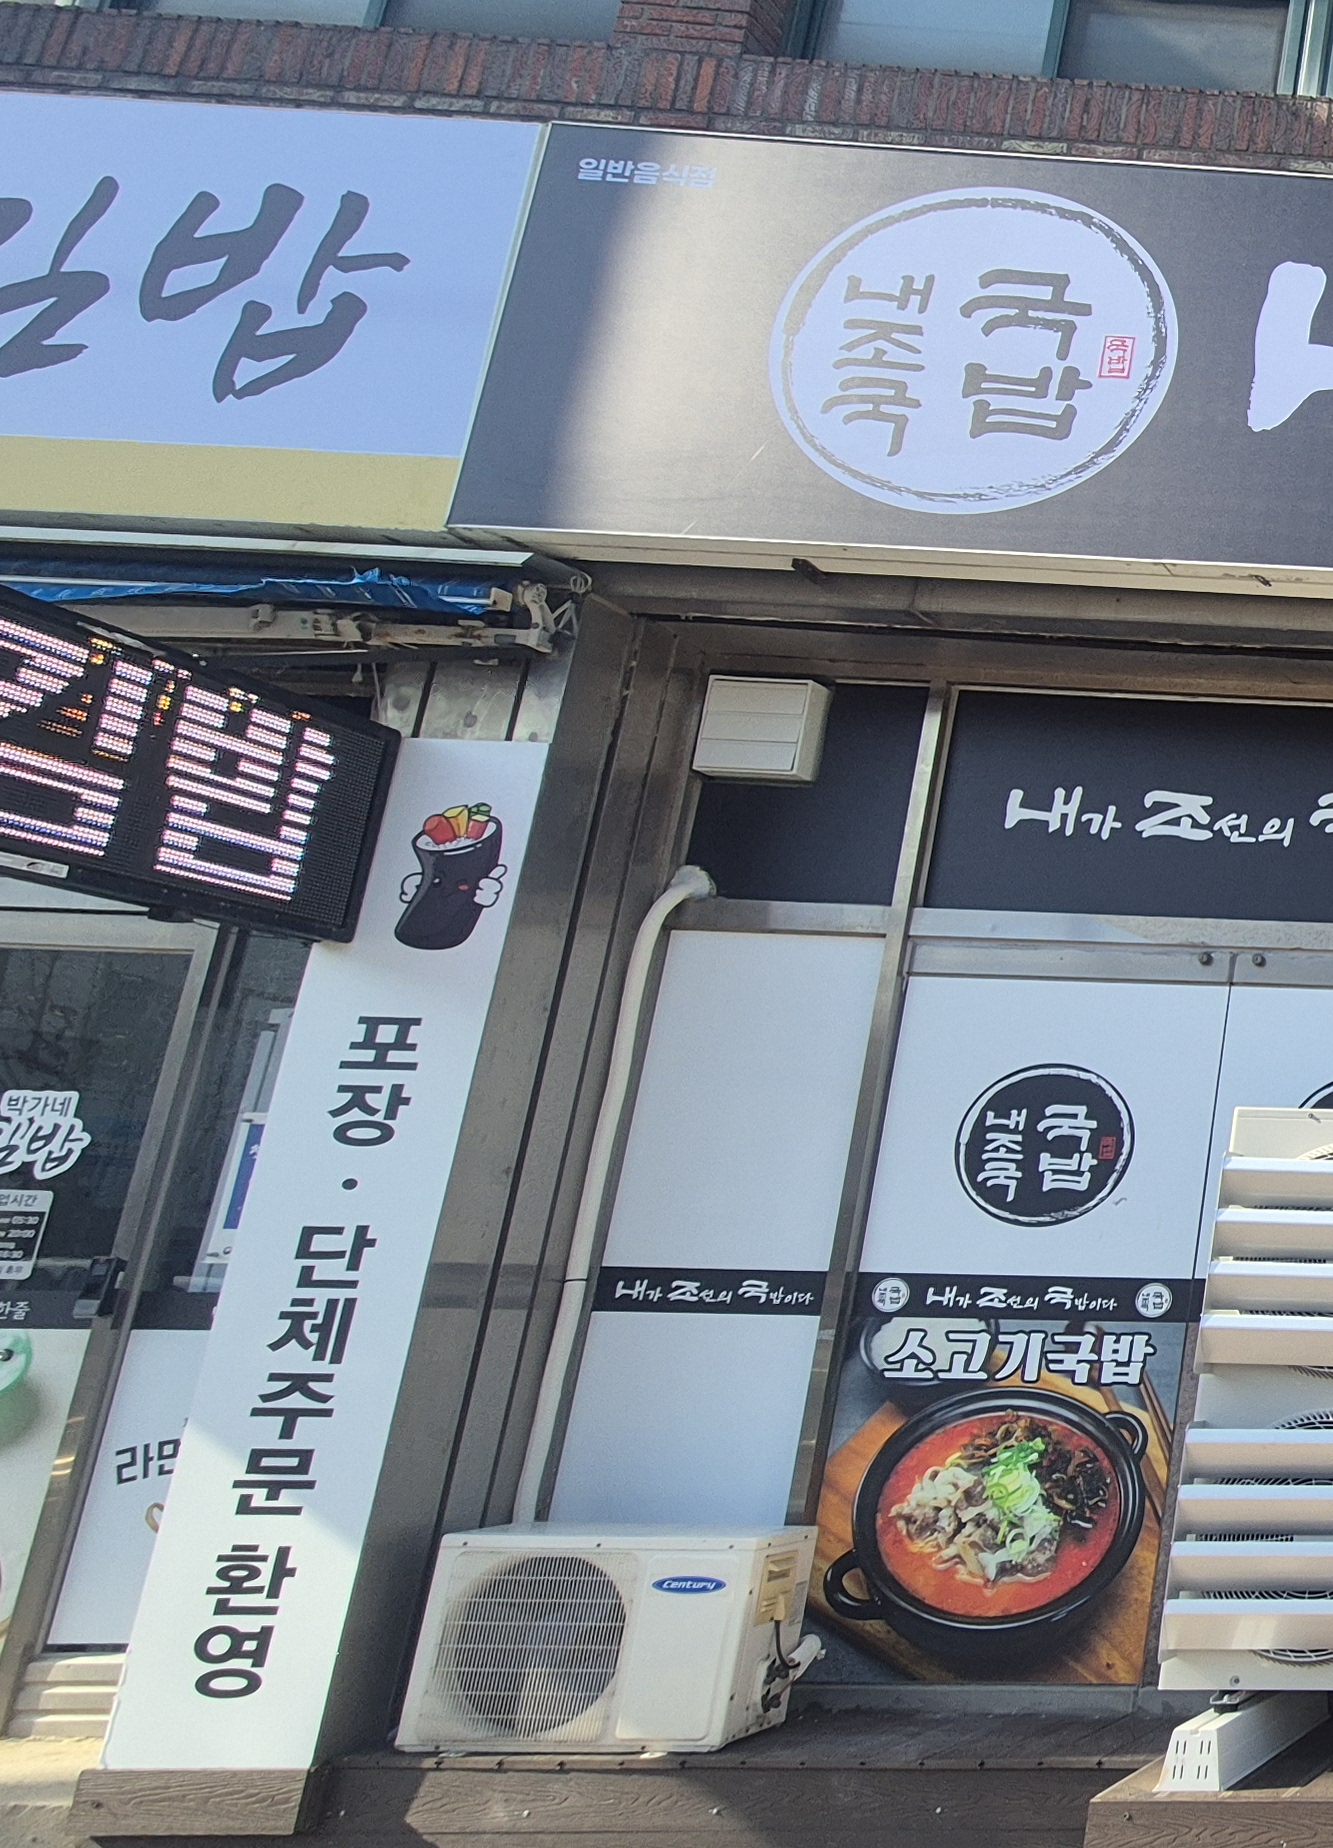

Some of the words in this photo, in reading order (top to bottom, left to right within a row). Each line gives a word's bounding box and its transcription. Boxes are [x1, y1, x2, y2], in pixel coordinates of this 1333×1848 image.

[577, 157, 718, 189] 일반음식점
[821, 274, 935, 457] 내조국
[959, 269, 1093, 440] 국밥
[1004, 786, 1122, 840] 내가
[1135, 790, 1295, 848] 조선의
[7, 1094, 73, 1117] 박가네
[328, 1016, 423, 1147] 포장
[977, 1108, 1028, 1202] 내조국
[1037, 1104, 1098, 1192] 국밥
[615, 1278, 662, 1302] 내가
[667, 1280, 733, 1305] 조선의
[738, 1279, 814, 1306] 국밥이다
[926, 1285, 972, 1309] 내가
[976, 1286, 1039, 1311] 조선의
[1044, 1285, 1118, 1312] 국밥이다
[232, 1225, 378, 1517] 단체주문
[883, 1330, 1155, 1384] 소고기국밥
[193, 1544, 297, 1699] 환영
[662, 1580, 716, 1591] Century
